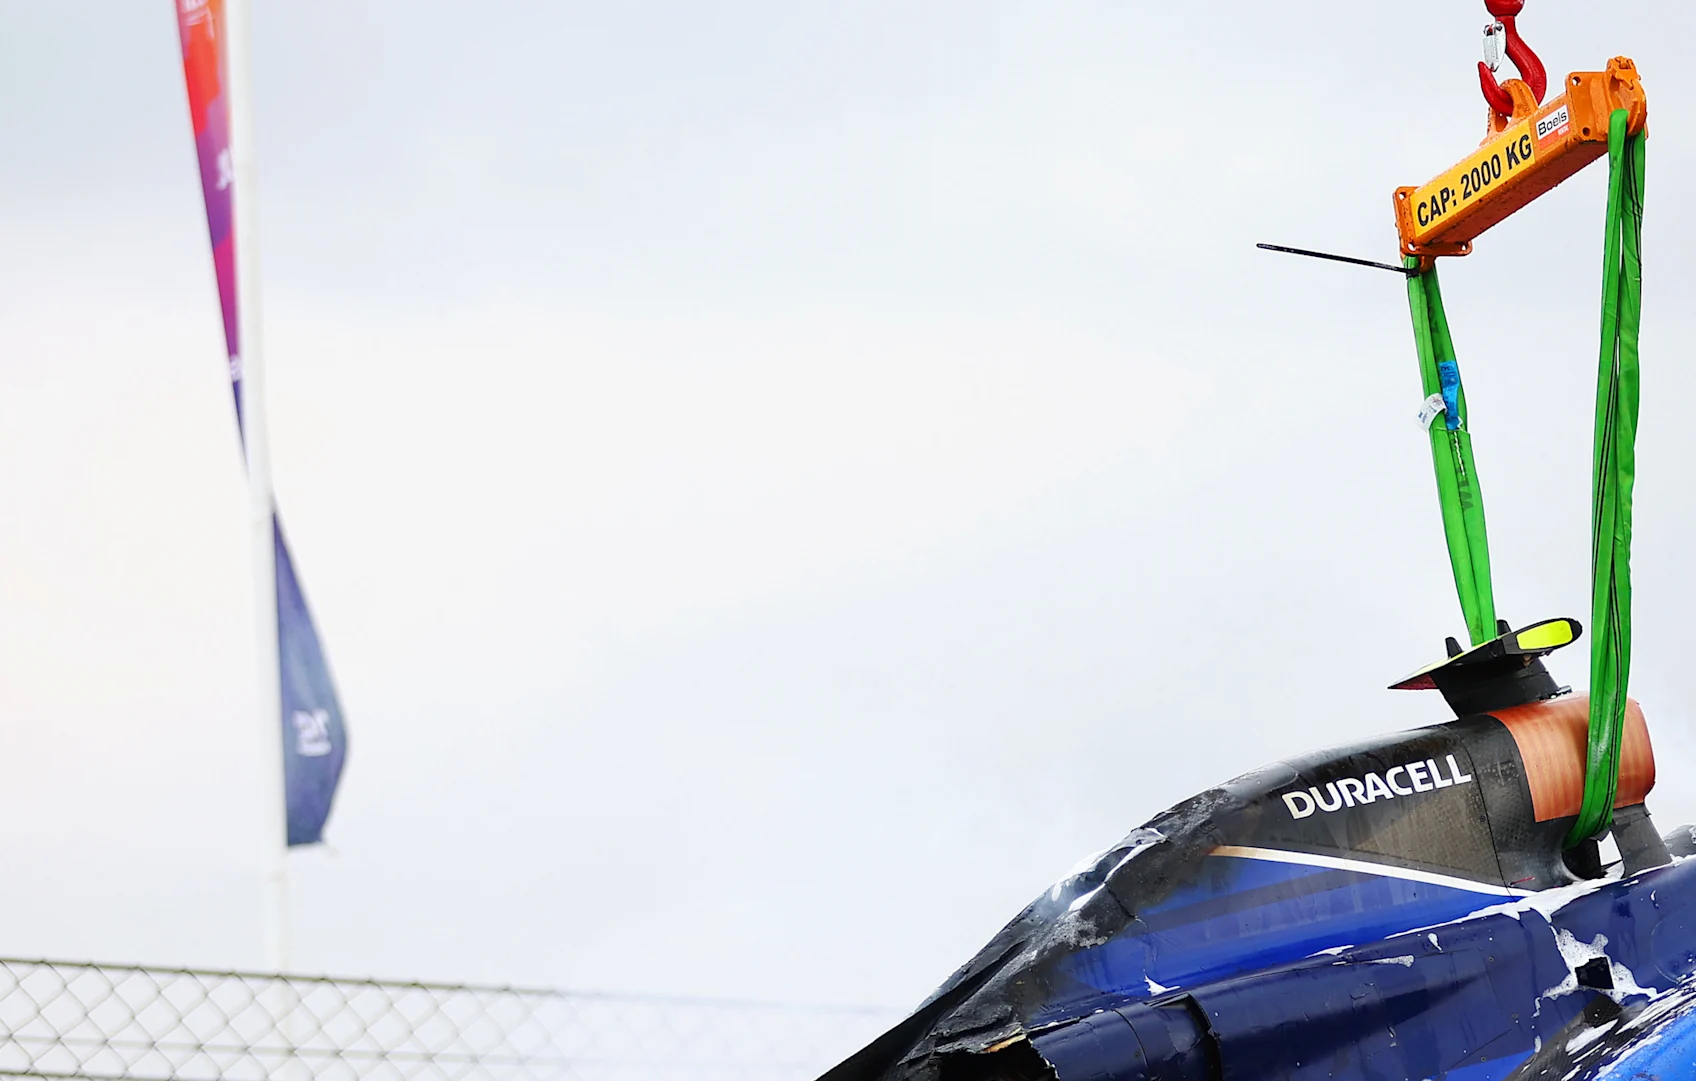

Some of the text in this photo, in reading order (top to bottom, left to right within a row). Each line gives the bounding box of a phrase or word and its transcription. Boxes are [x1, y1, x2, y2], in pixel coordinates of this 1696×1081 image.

[1538, 112, 1567, 136] Boels
[1416, 134, 1532, 227] CAP: 2000 KG
[1281, 753, 1472, 819] DURACELL
